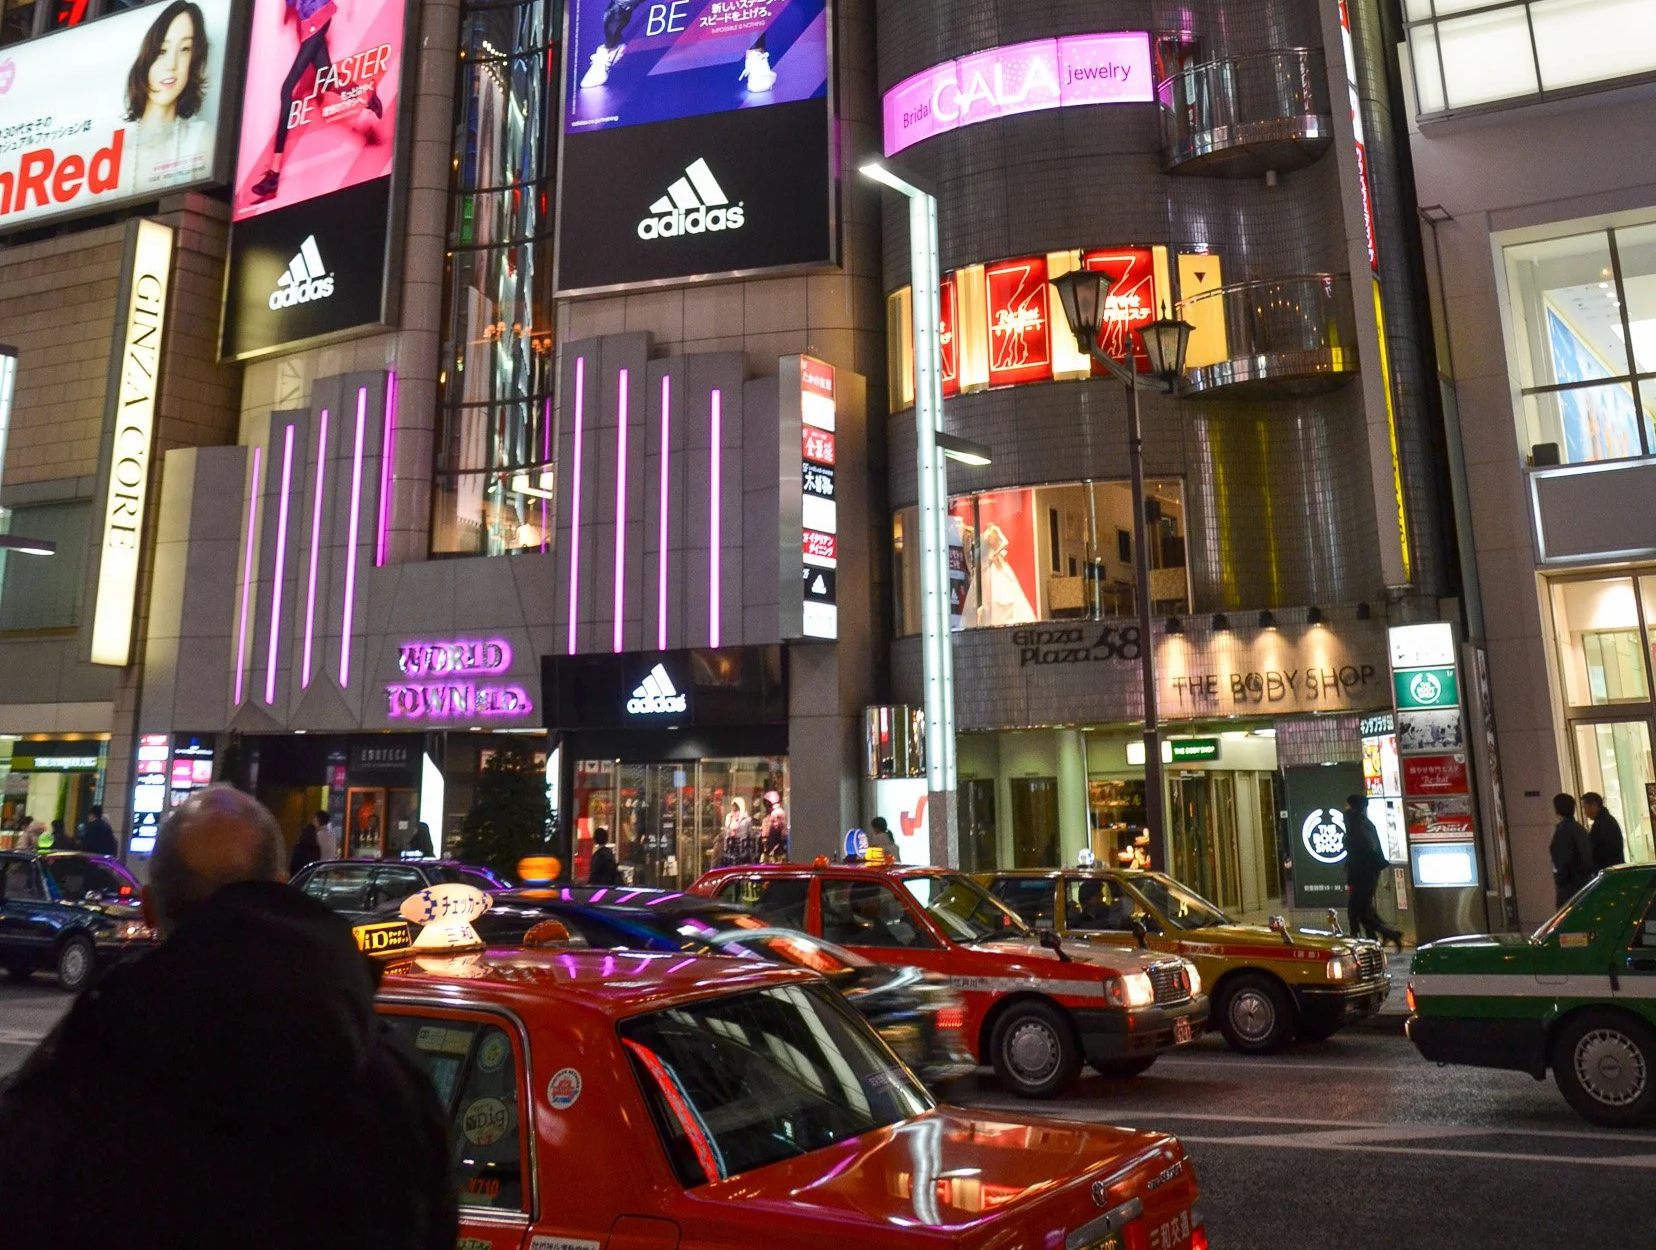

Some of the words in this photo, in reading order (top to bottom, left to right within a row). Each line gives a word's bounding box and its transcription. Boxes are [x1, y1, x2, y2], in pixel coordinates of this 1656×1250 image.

[646, 0, 688, 36] BE
[699, 6, 772, 28] スピードを上げろ。
[312, 43, 392, 97] FASTER
[903, 97, 932, 130] Bridal
[1067, 62, 1132, 86] jewelry
[287, 96, 314, 130] BE
[637, 204, 745, 240] adidas
[269, 275, 334, 310] adidas
[124, 273, 161, 408] GINZA
[108, 426, 145, 549] CORE
[1012, 627, 1083, 646] Ginza
[1020, 648, 1091, 667] Plaza
[1094, 627, 1142, 661] 58
[398, 642, 503, 673] WORLD
[1172, 674, 1219, 697] THE
[1231, 670, 1299, 694] BODY
[1306, 664, 1377, 690] SHOP
[385, 686, 468, 713] TOWN
[627, 695, 686, 713] adidas
[1312, 833, 1344, 844] BODY
[1318, 824, 1337, 834] THE
[1315, 842, 1344, 853] SHOP
[442, 894, 480, 916] チェッカー
[364, 931, 388, 949] iD
[444, 926, 474, 942] 三和
[1188, 946, 1224, 954] TAXI
[1150, 1209, 1190, 1250] 三和交通
